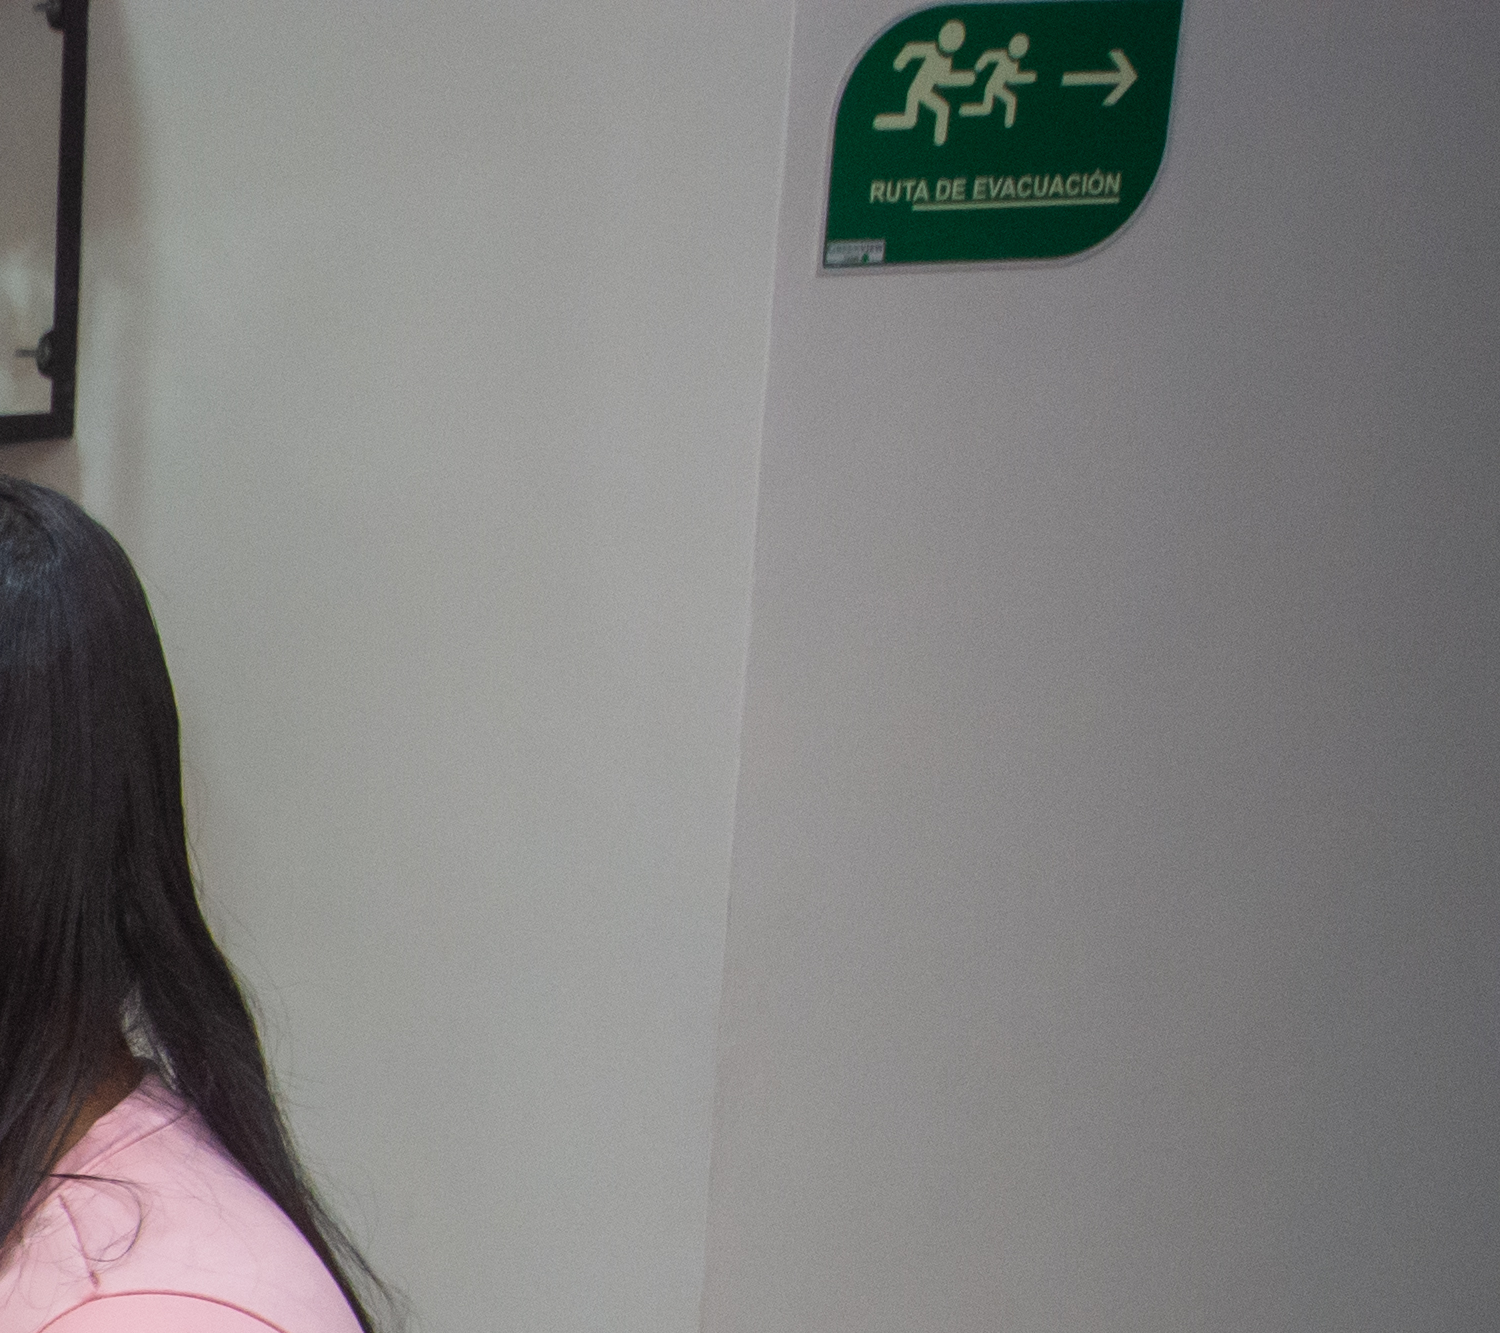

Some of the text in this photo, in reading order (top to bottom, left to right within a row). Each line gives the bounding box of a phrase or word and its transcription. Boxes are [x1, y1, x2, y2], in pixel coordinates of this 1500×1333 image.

[869, 168, 1121, 204] RUTA DE EVACUACIÓN
